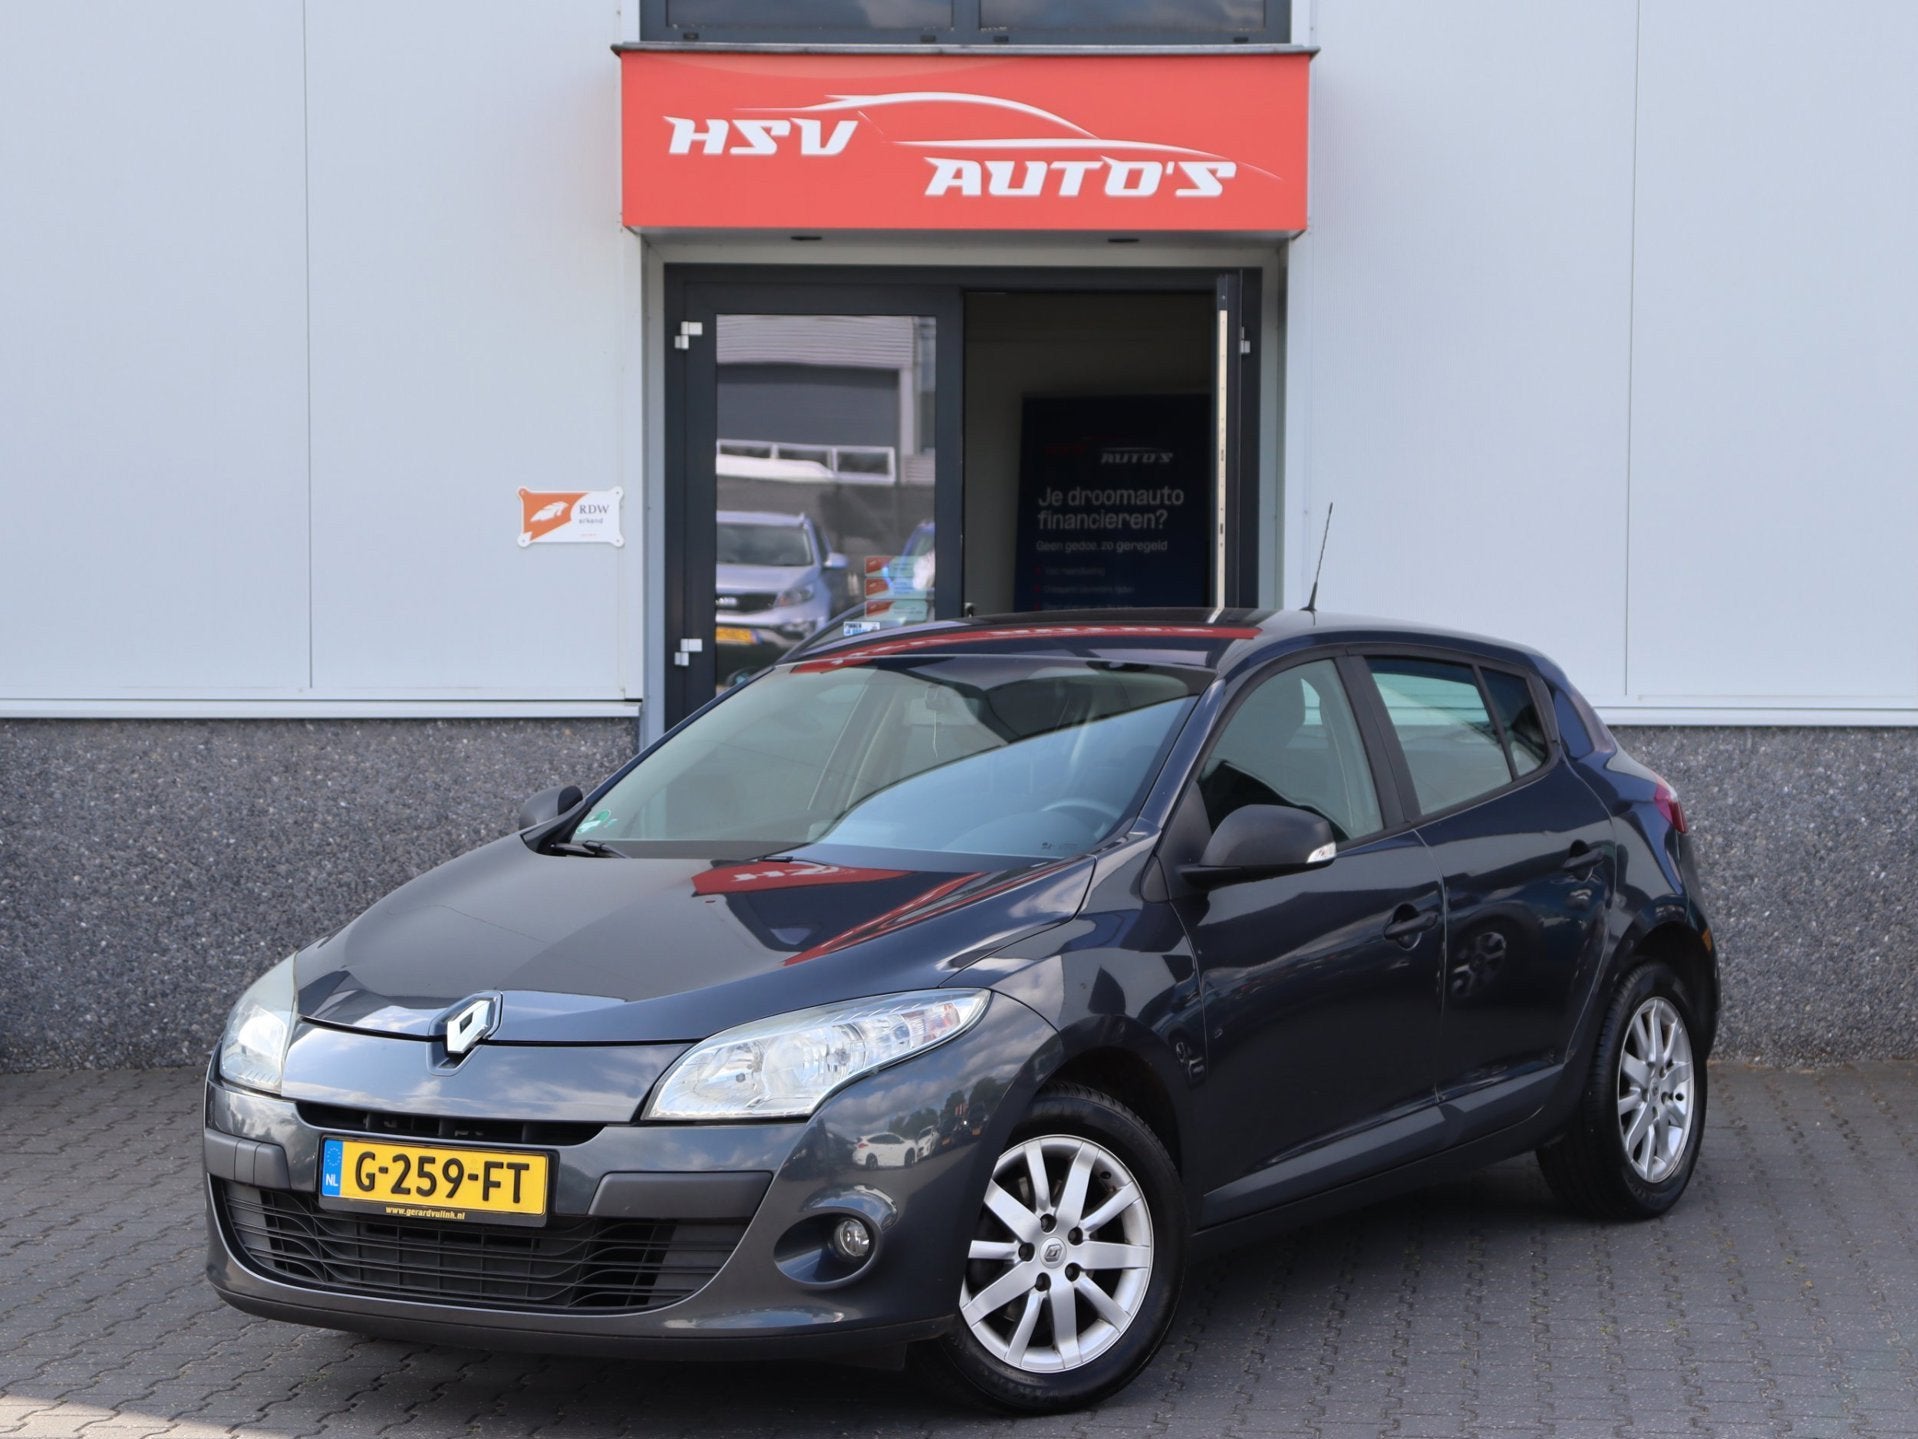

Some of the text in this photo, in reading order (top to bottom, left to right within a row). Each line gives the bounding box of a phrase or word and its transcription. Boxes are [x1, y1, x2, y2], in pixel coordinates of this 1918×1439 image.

[663, 116, 858, 155] HSV
[924, 156, 1237, 197] AUTO'S
[1038, 485, 1184, 506] Je droomauto
[579, 504, 609, 514] RDW
[1038, 508, 1168, 530] financieren?
[325, 1173, 339, 1187] NL
[355, 1150, 530, 1204] G-259-FT
